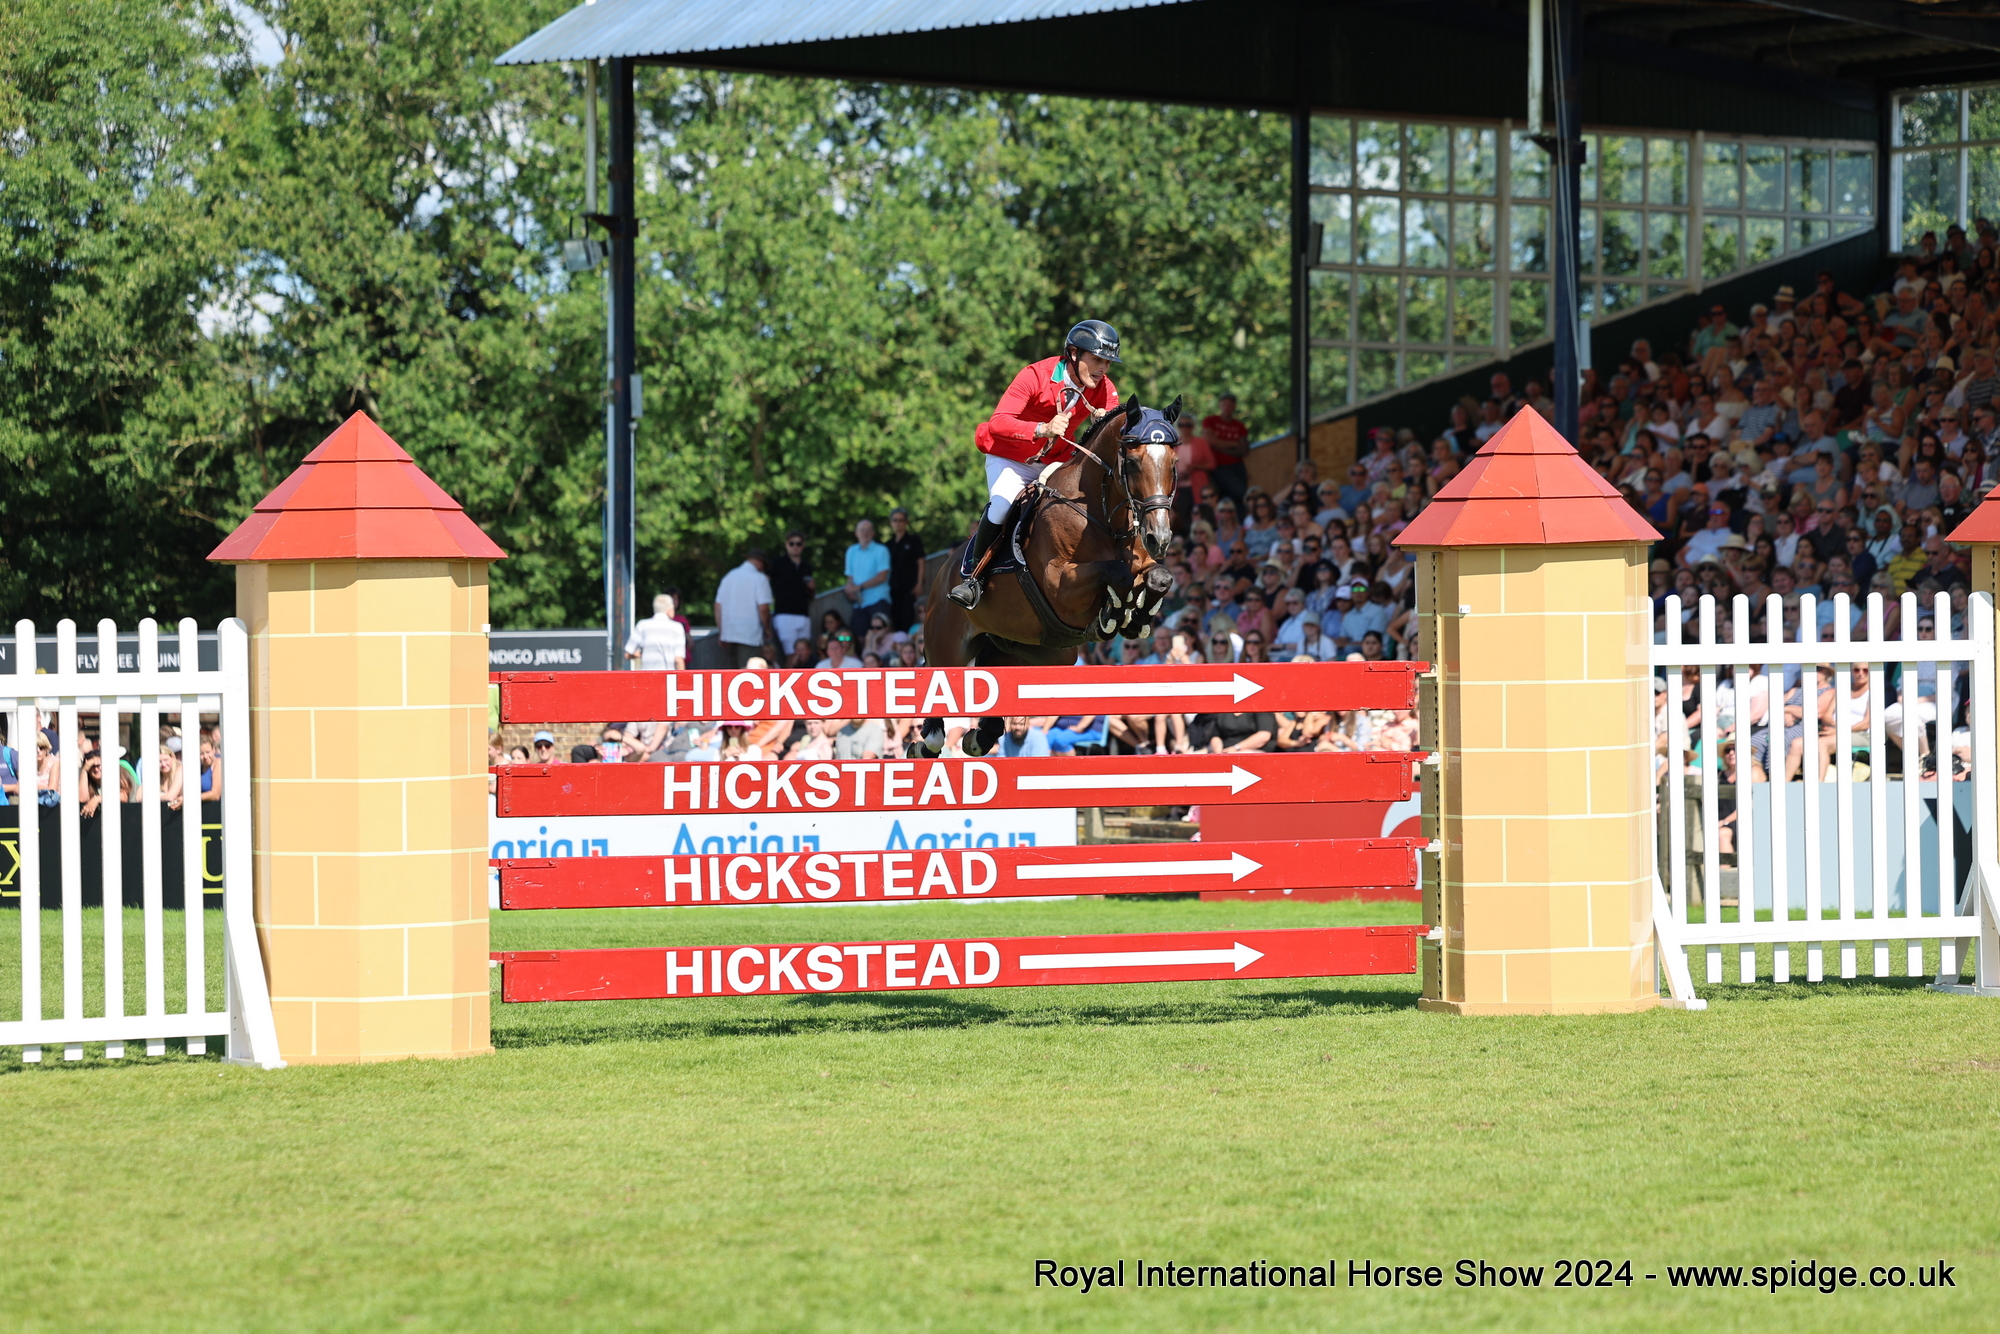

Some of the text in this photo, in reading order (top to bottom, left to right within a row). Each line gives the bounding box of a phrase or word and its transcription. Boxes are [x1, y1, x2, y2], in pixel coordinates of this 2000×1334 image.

[77, 653, 99, 669] FLY
[488, 647, 583, 666] NDIGO JEWELS
[666, 670, 1000, 717] HICKSTEAD
[663, 761, 998, 810] HICKSTEAD
[491, 825, 574, 859] ria
[663, 851, 998, 902] HICKSTEAD
[666, 941, 1000, 995] HICKSTEAD
